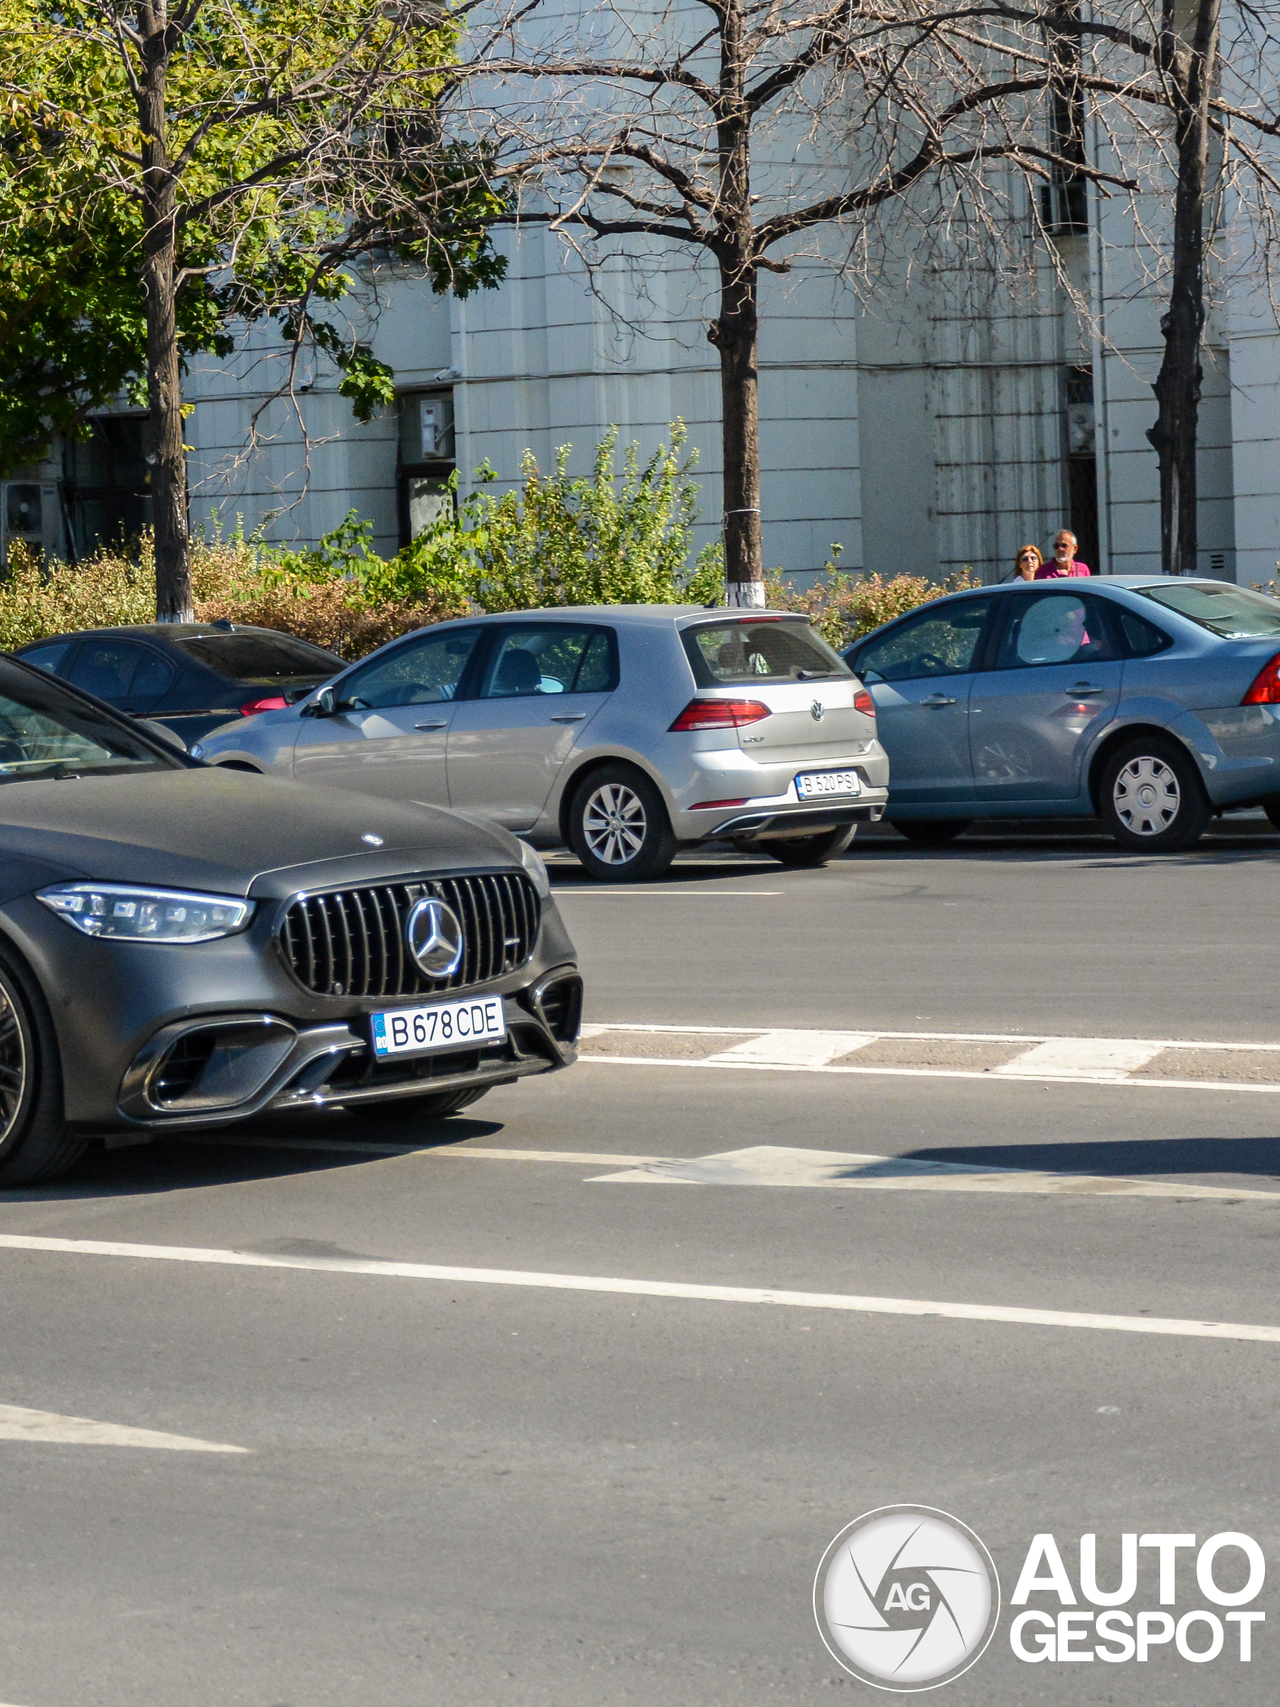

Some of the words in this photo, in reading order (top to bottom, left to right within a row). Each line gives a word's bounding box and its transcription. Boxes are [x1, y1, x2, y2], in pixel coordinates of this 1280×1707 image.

[392, 1016, 408, 1047] B
[413, 1010, 453, 1043] 678
[457, 1003, 499, 1036] CDE
